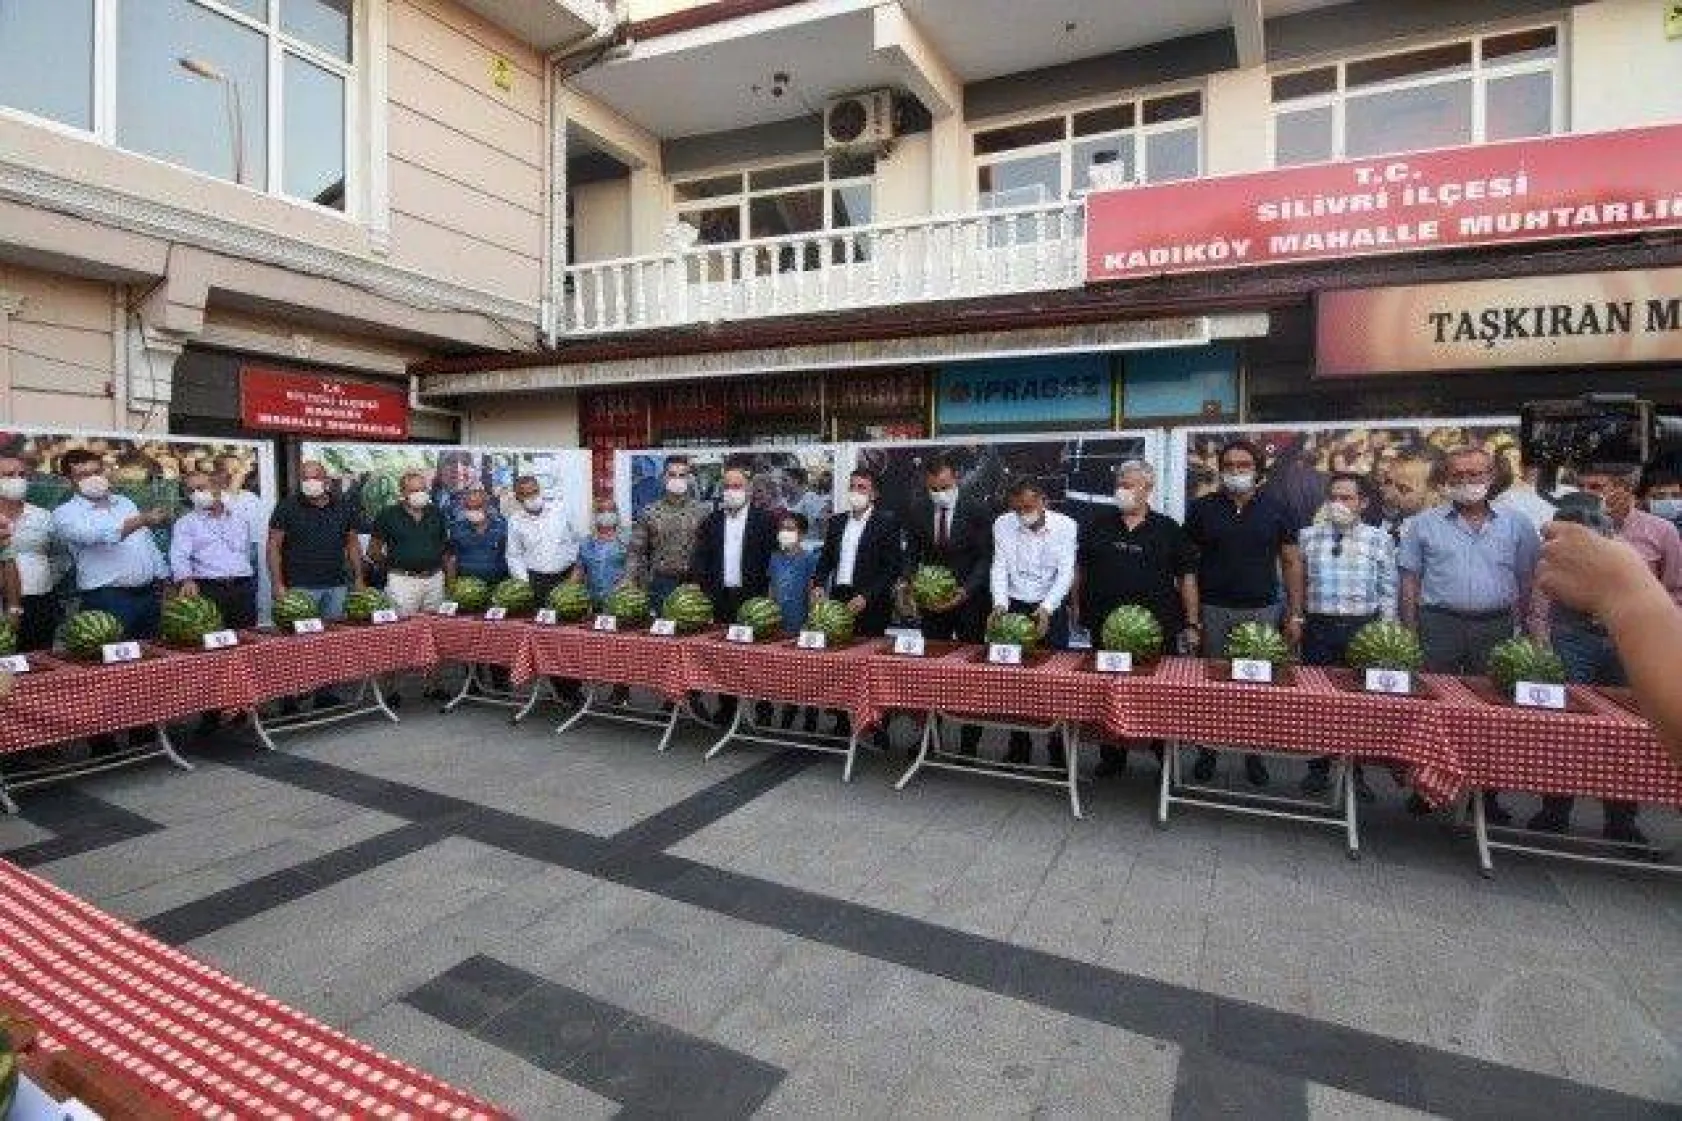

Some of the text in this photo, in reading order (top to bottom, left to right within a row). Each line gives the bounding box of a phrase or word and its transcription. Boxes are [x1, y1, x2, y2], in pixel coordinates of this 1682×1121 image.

[1355, 162, 1422, 185] T.C.
[1402, 172, 1528, 206] İLÇESİ
[1104, 236, 1251, 270] KADIKÖY
[1269, 220, 1439, 254] MAHALLE
[1429, 303, 1633, 348] TAŞKIRAN
